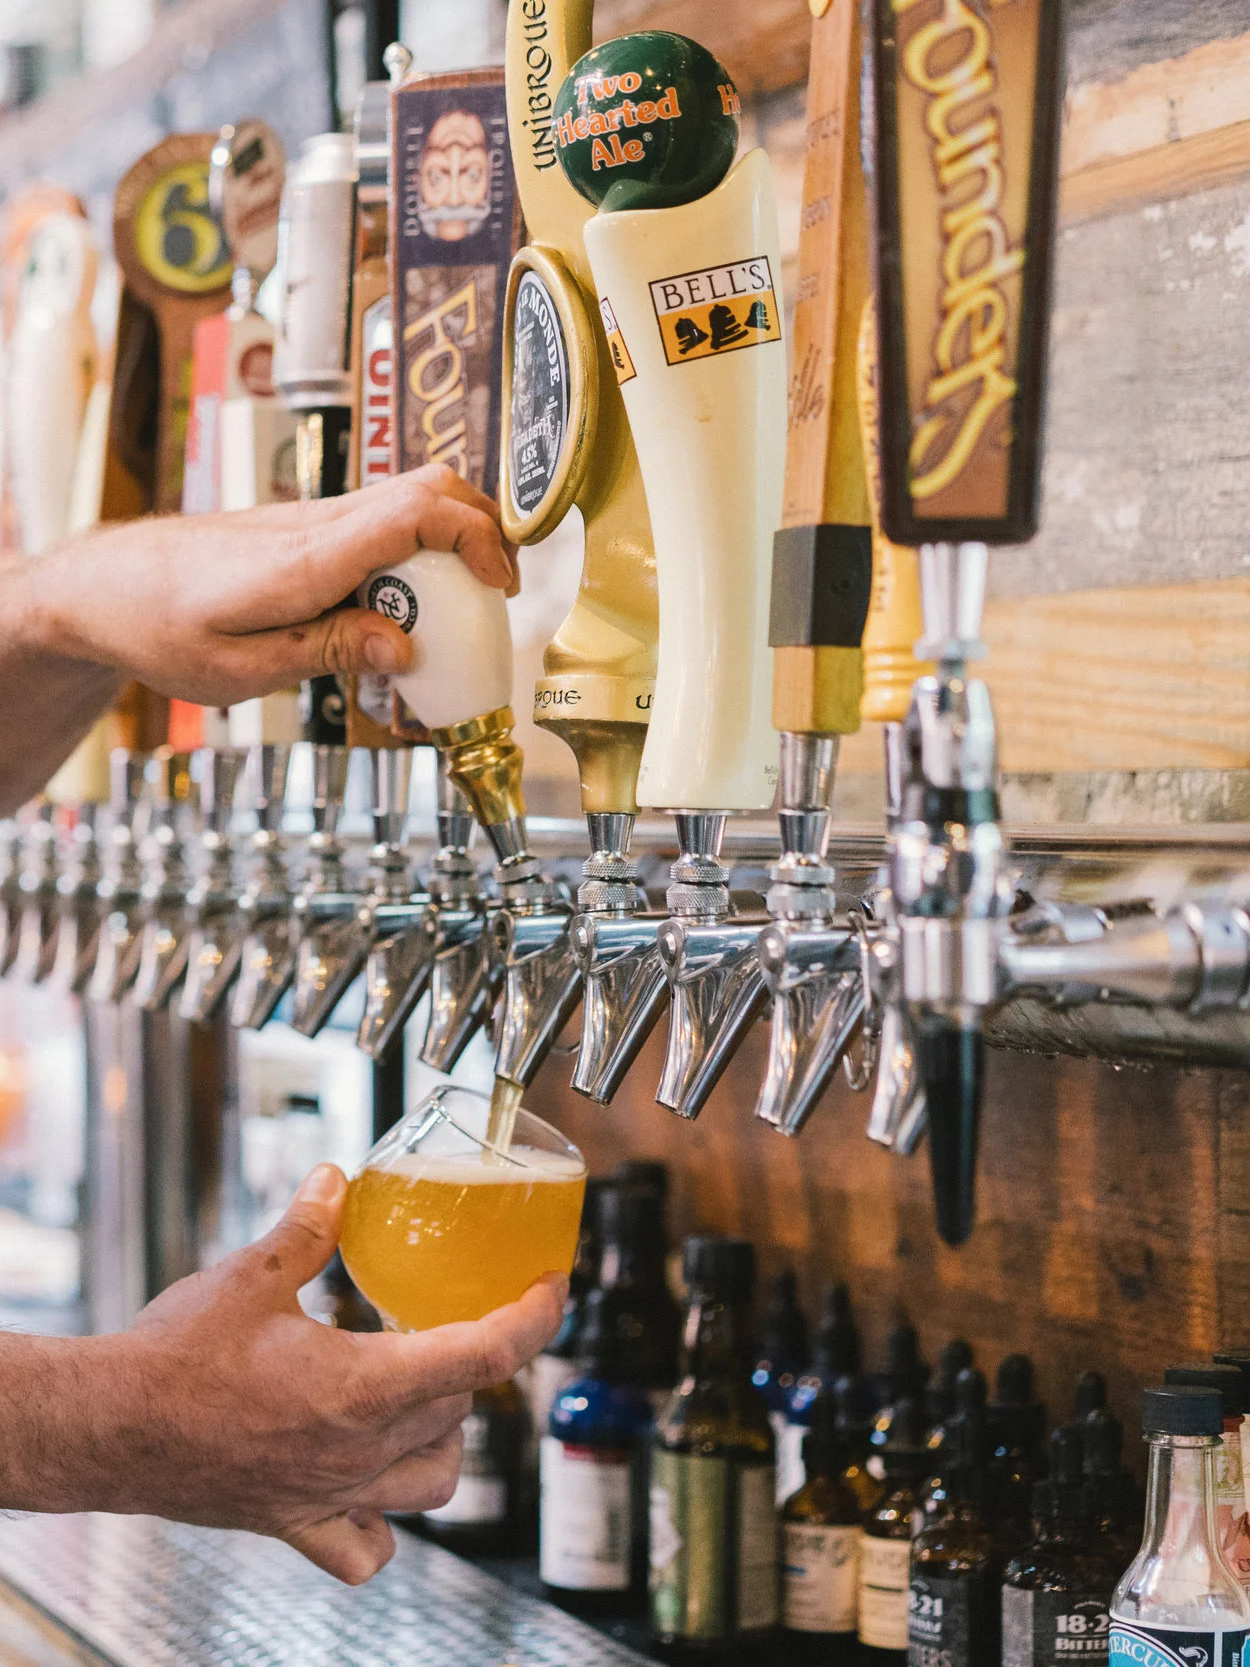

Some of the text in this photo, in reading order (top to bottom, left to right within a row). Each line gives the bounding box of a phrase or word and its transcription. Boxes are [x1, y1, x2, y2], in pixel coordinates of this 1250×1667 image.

[574, 71, 642, 105] Two
[556, 86, 682, 148] Hearted
[591, 133, 645, 171] Ale
[660, 264, 766, 310] BELL'S
[529, 286, 560, 387] MONDE
